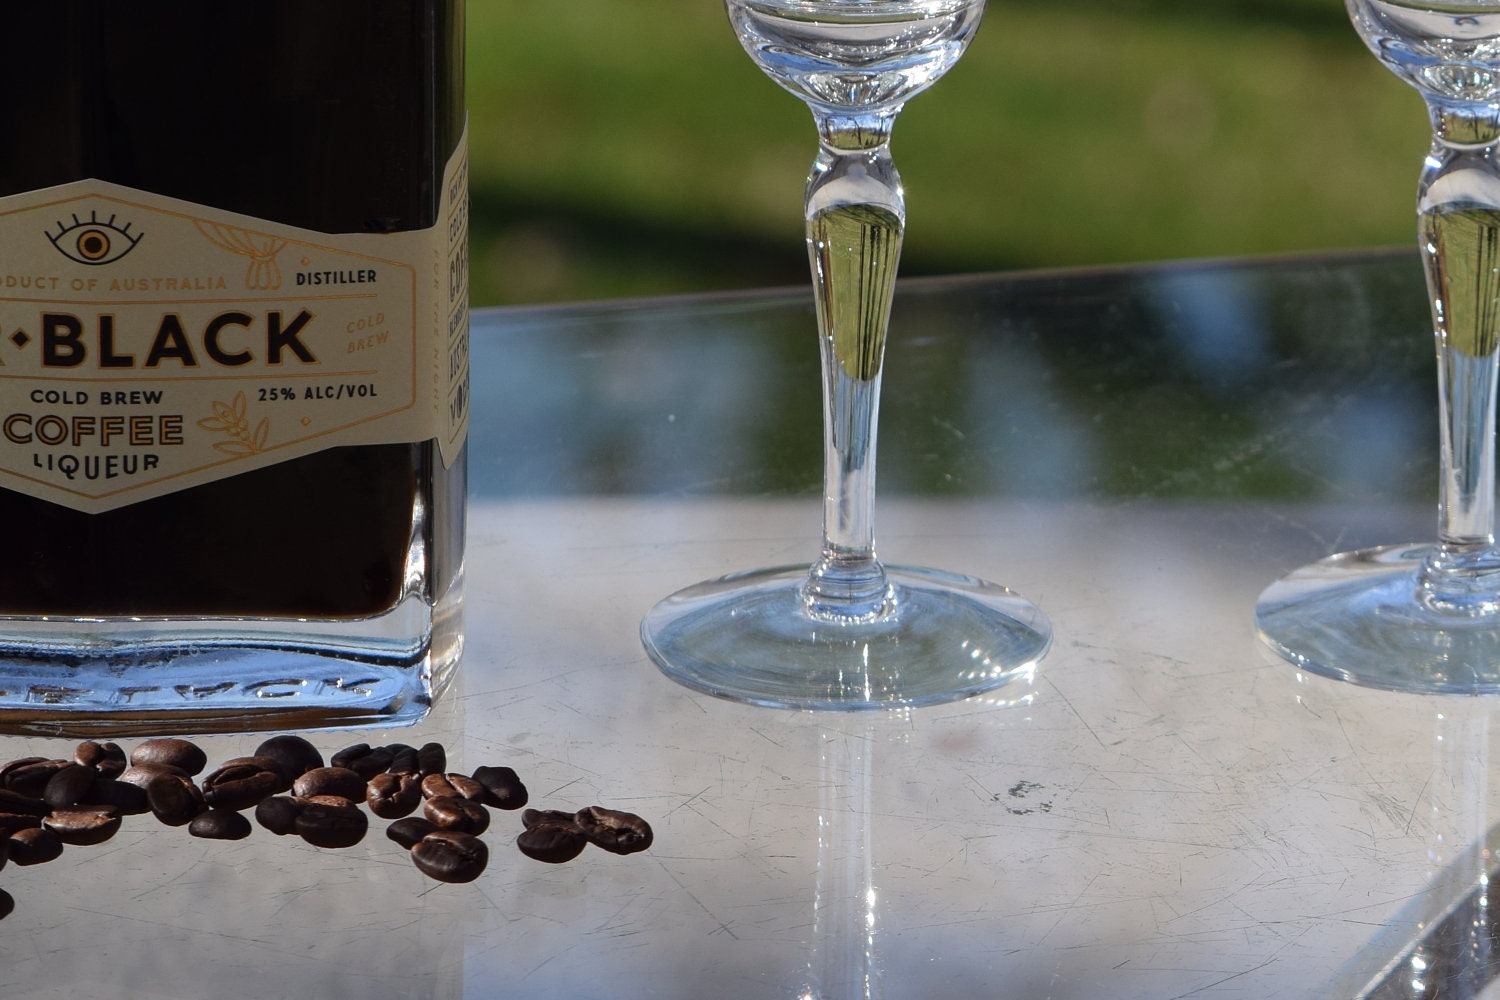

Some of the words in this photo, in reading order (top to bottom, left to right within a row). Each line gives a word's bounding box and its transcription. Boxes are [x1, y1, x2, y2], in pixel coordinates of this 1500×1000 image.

[0, 275, 60, 290] DUCT
[70, 278, 98, 292] OF
[109, 276, 227, 292] AUSTRALIA
[296, 270, 377, 286] DISTILLER
[346, 313, 385, 333] COLD
[40, 309, 321, 369] BLACK
[347, 331, 389, 353] BREW
[30, 390, 89, 405] COLD
[100, 391, 163, 405] BREW
[258, 388, 296, 401] 25%
[304, 384, 377, 400] ALC/VOL
[3, 413, 183, 446] COFFEE
[33, 454, 160, 480] LIQUEUR
